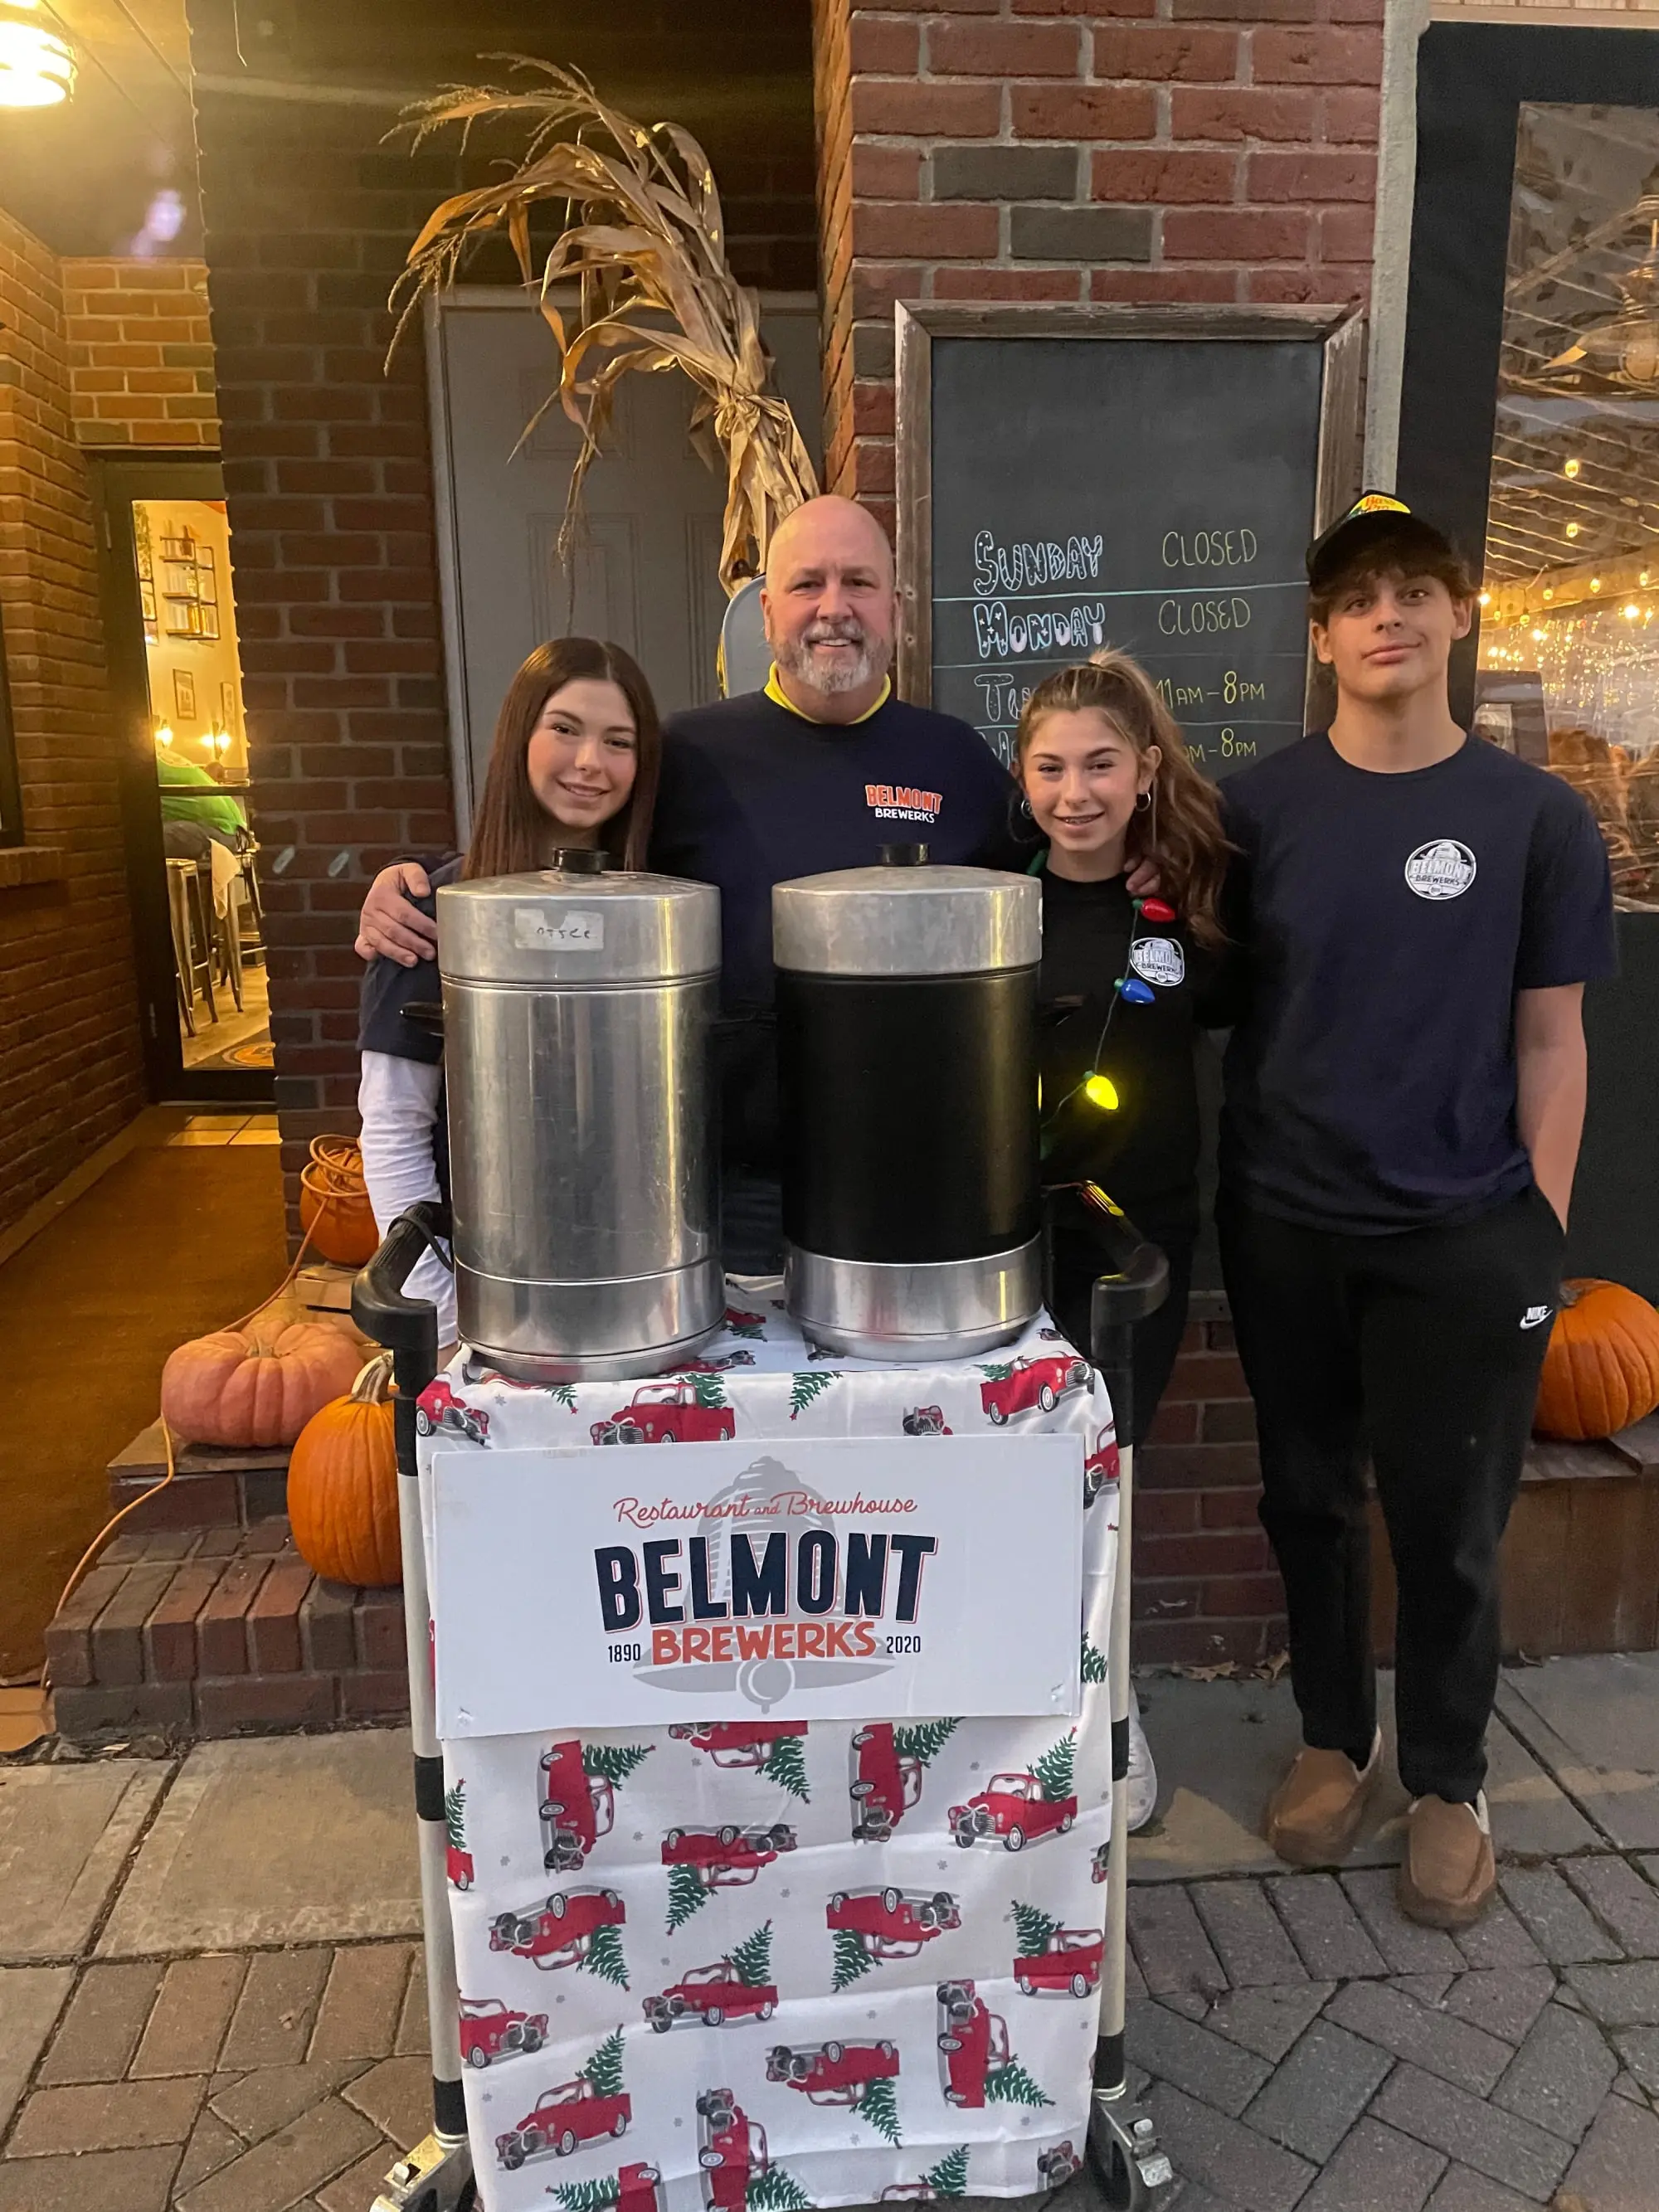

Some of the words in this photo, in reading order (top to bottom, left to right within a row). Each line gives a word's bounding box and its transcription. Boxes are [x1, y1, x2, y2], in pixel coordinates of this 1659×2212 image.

[1162, 528, 1258, 567] CLOSED
[1158, 597, 1251, 635] CLOSED
[865, 785, 943, 814] BELMONT
[875, 807, 935, 824] BREWERKS
[1411, 860, 1472, 882] BELMONT
[1526, 1305, 1548, 1320] NIKE
[613, 1494, 751, 1529] Restaurant
[754, 1500, 781, 1515] and
[781, 1491, 917, 1516] Brewhouse
[594, 1529, 938, 1634] BELMONT
[607, 1643, 641, 1663] 1890
[652, 1621, 876, 1665] BREWERKS
[886, 1636, 922, 1654] 2020
